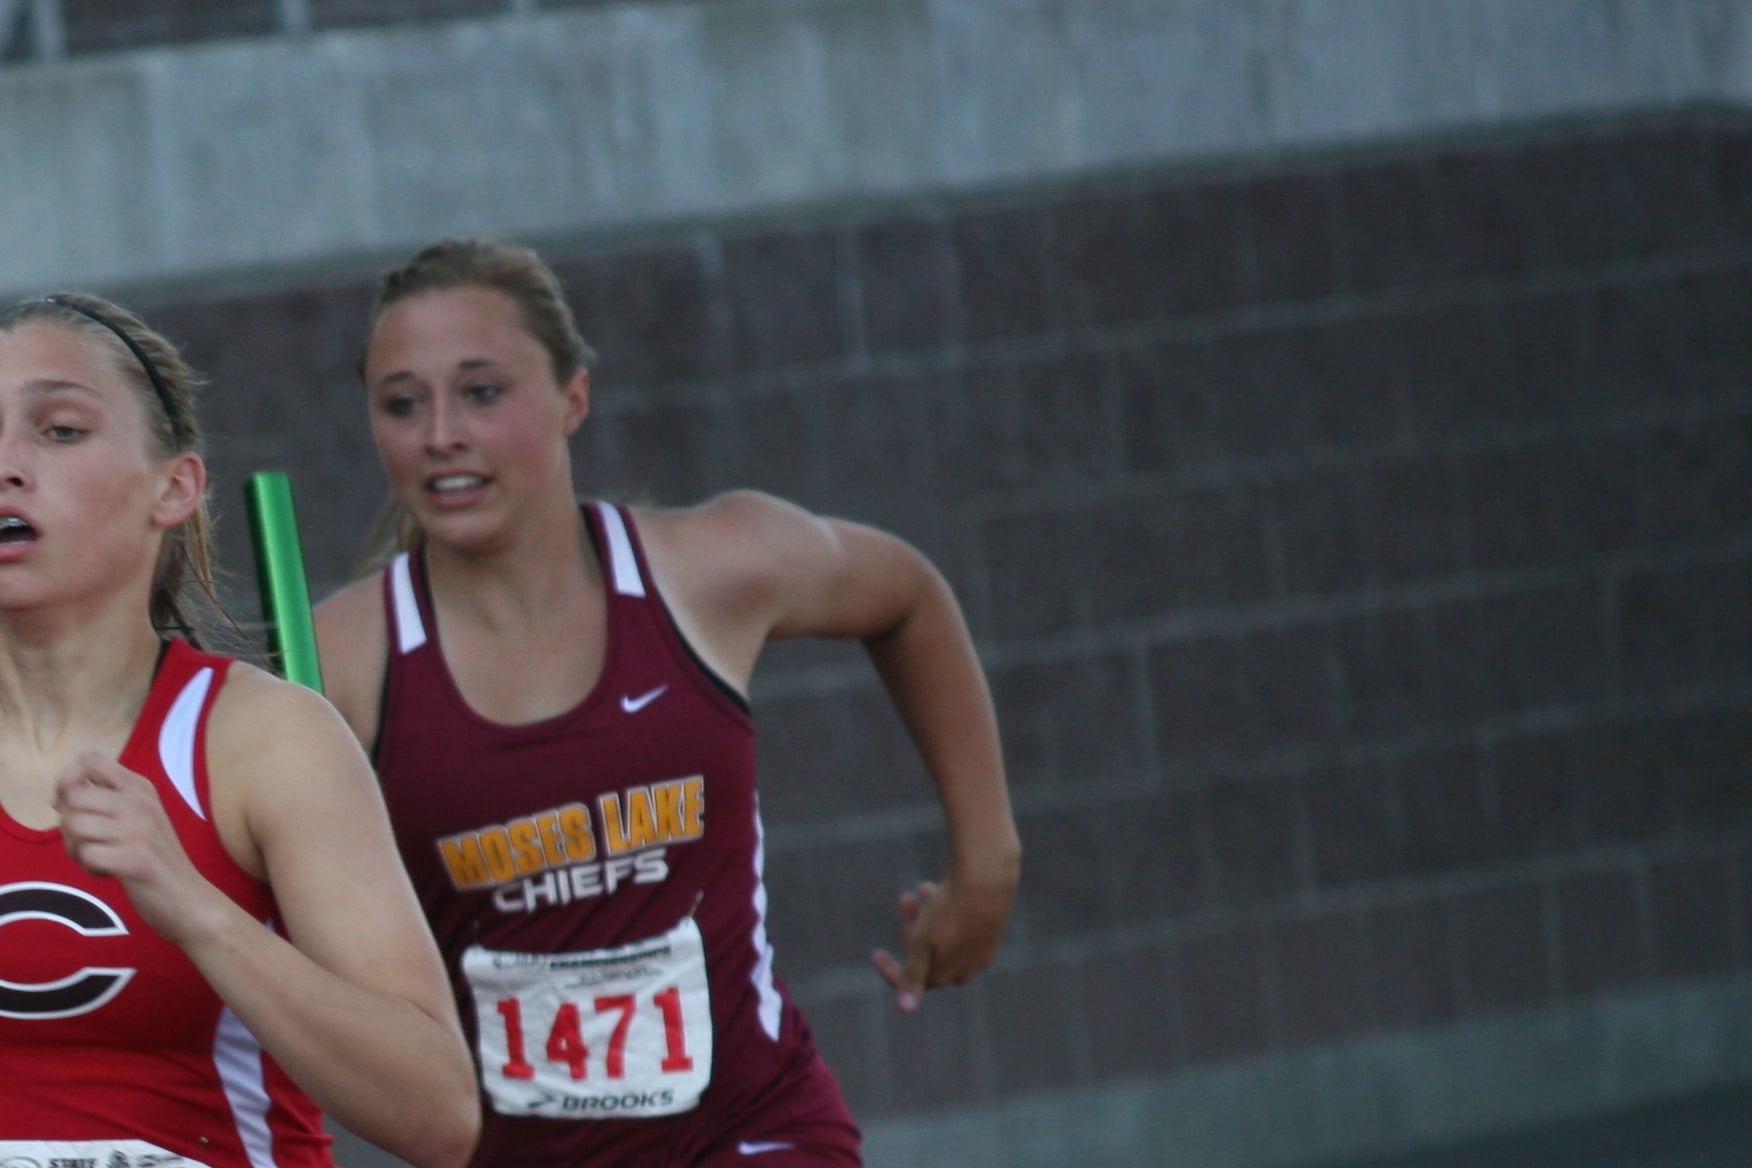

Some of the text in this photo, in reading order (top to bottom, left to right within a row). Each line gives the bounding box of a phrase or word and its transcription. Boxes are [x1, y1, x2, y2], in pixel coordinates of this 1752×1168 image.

[437, 774, 704, 892] MOSES LAKE
[492, 848, 670, 913] CHIEFS
[496, 985, 693, 1081] 1471
[561, 1089, 673, 1112] BROOKS
